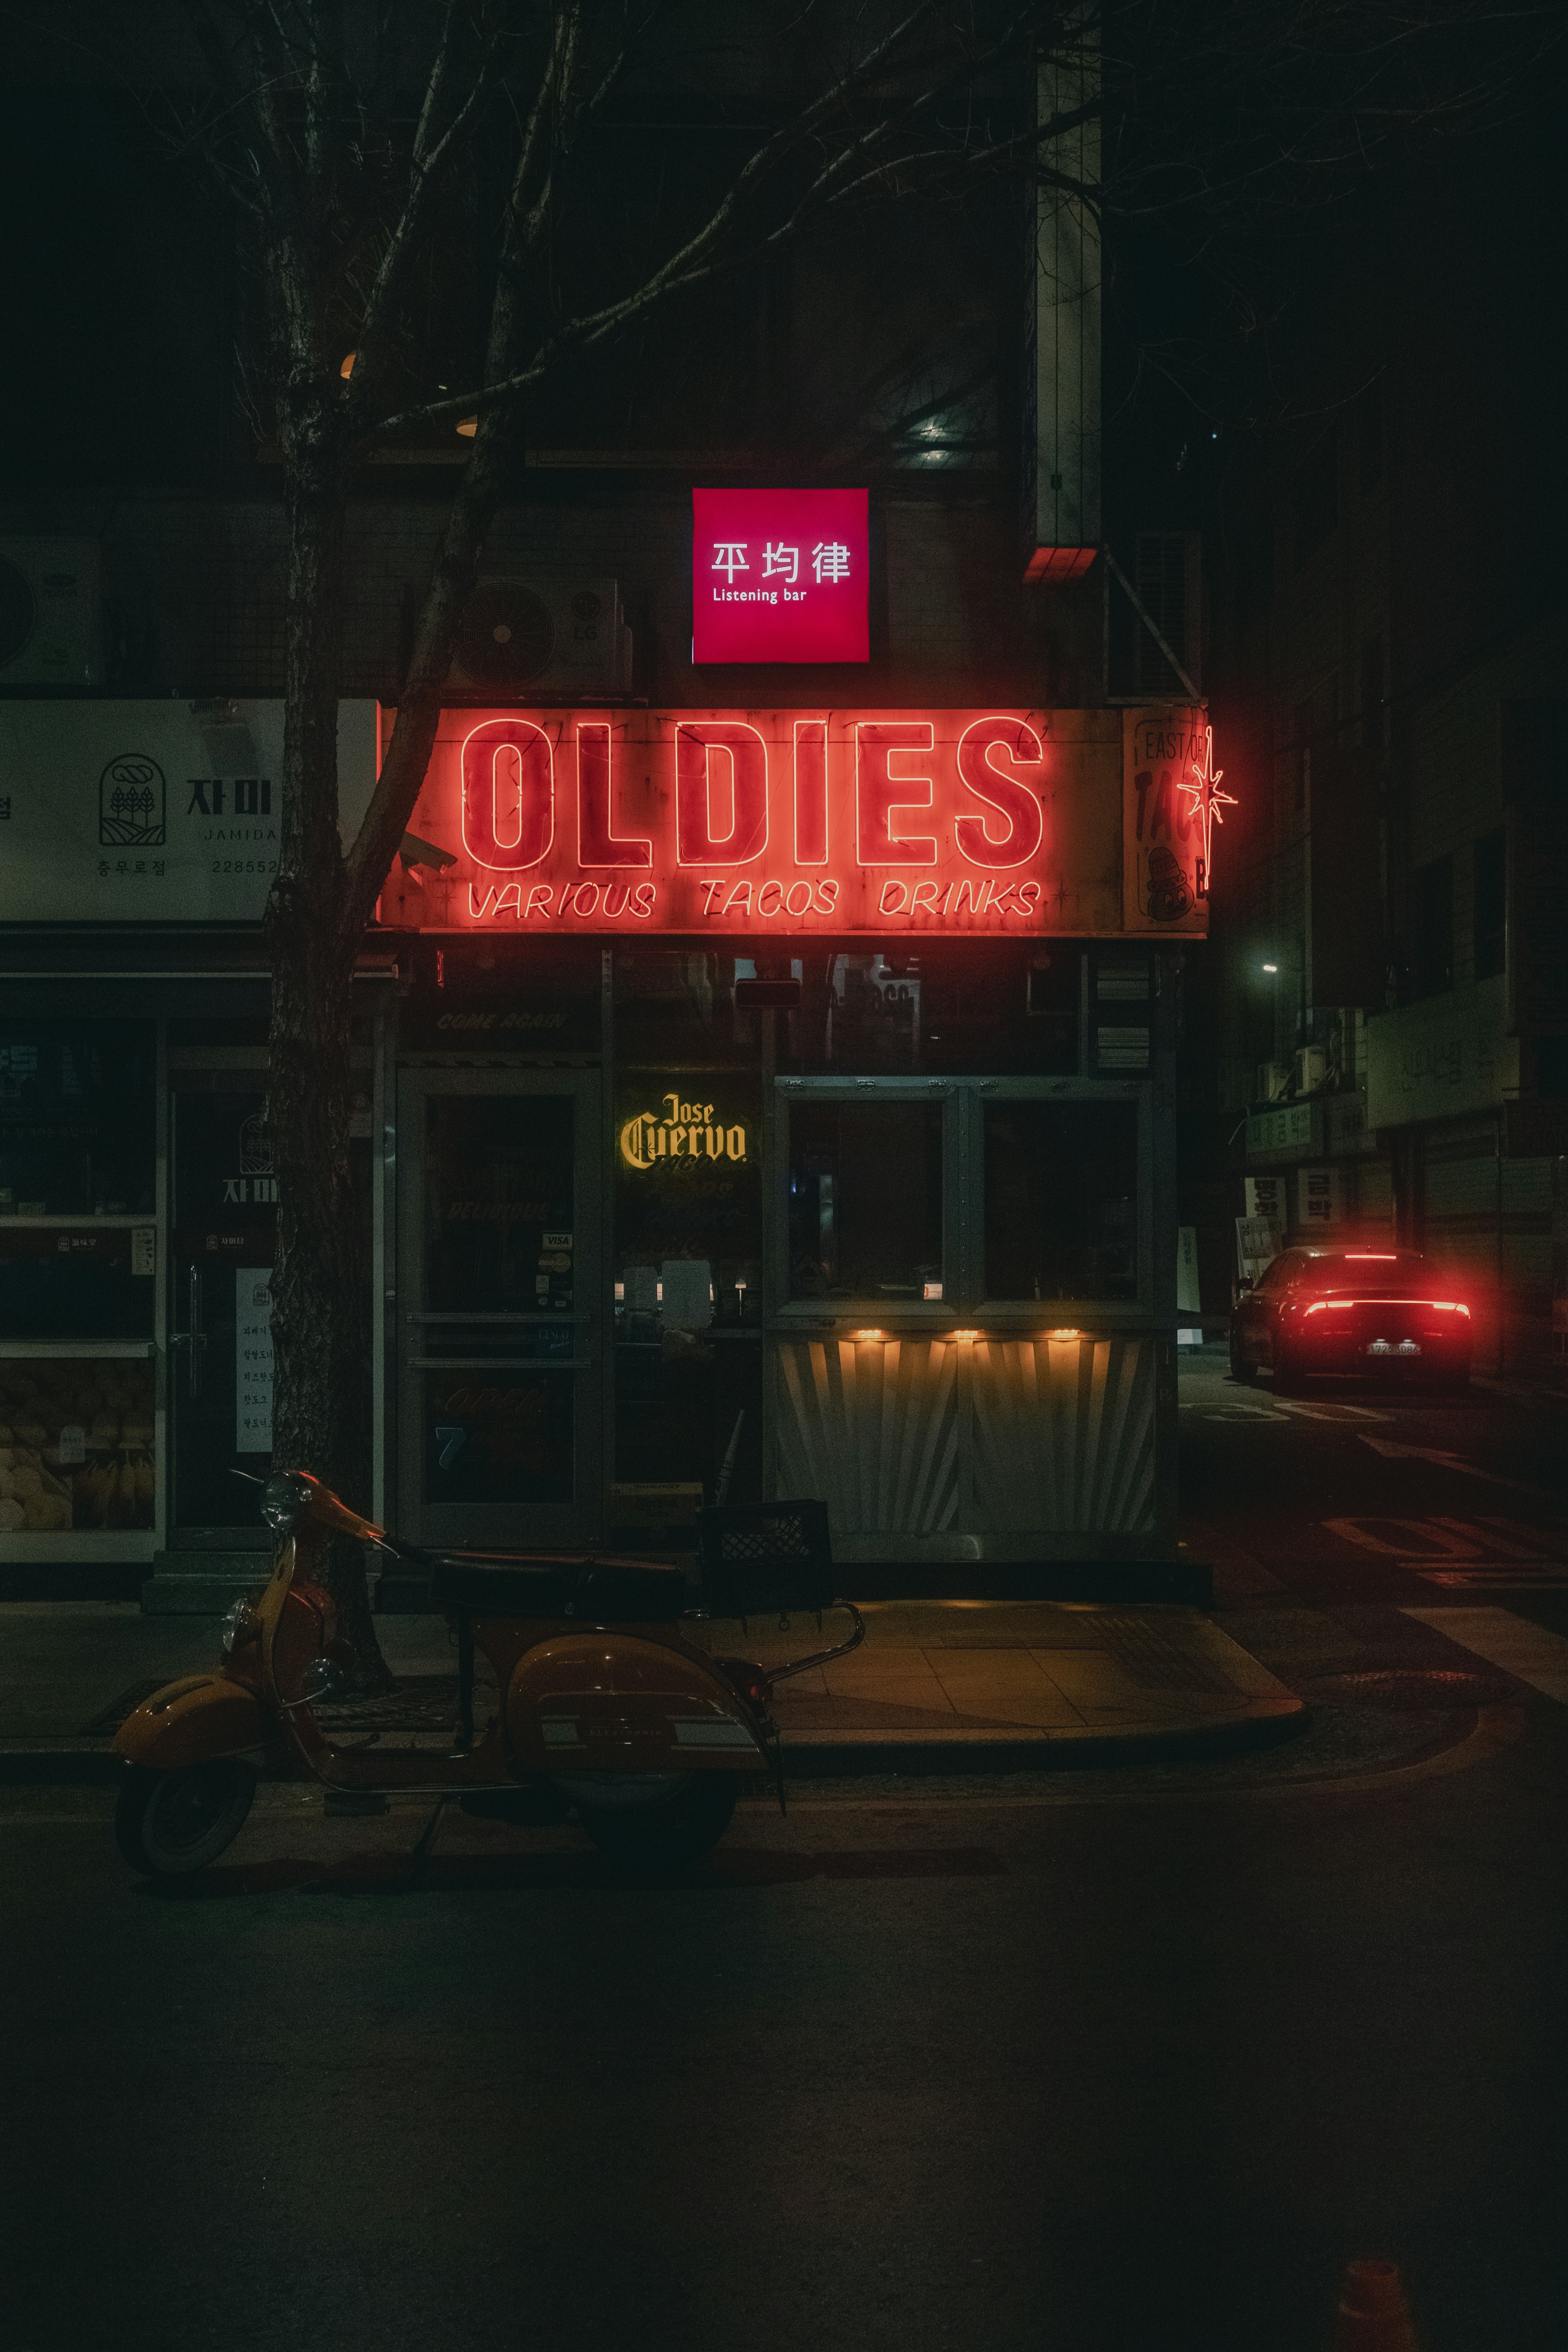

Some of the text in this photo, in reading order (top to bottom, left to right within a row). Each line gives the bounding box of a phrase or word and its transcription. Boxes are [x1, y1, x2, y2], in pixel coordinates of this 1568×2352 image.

[711, 542, 850, 584] 平均律
[713, 588, 807, 605] Listening bar
[574, 626, 597, 640] LG
[1146, 732, 1185, 759] EAST
[461, 716, 1043, 870] OLDIES
[96, 861, 166, 877] 충무로점
[469, 880, 1041, 918] VARIOUS TACOS DRINKS
[436, 1012, 568, 1030] COME AGAIN
[662, 1093, 714, 1126] Jose
[620, 1112, 746, 1170] Cuervo
[447, 1201, 551, 1221] DELICIOUS
[548, 1237, 569, 1245] VISA
[244, 1395, 267, 1405] 핫도그
[445, 1388, 551, 1416] OPEN
[435, 1426, 467, 1470] 7
